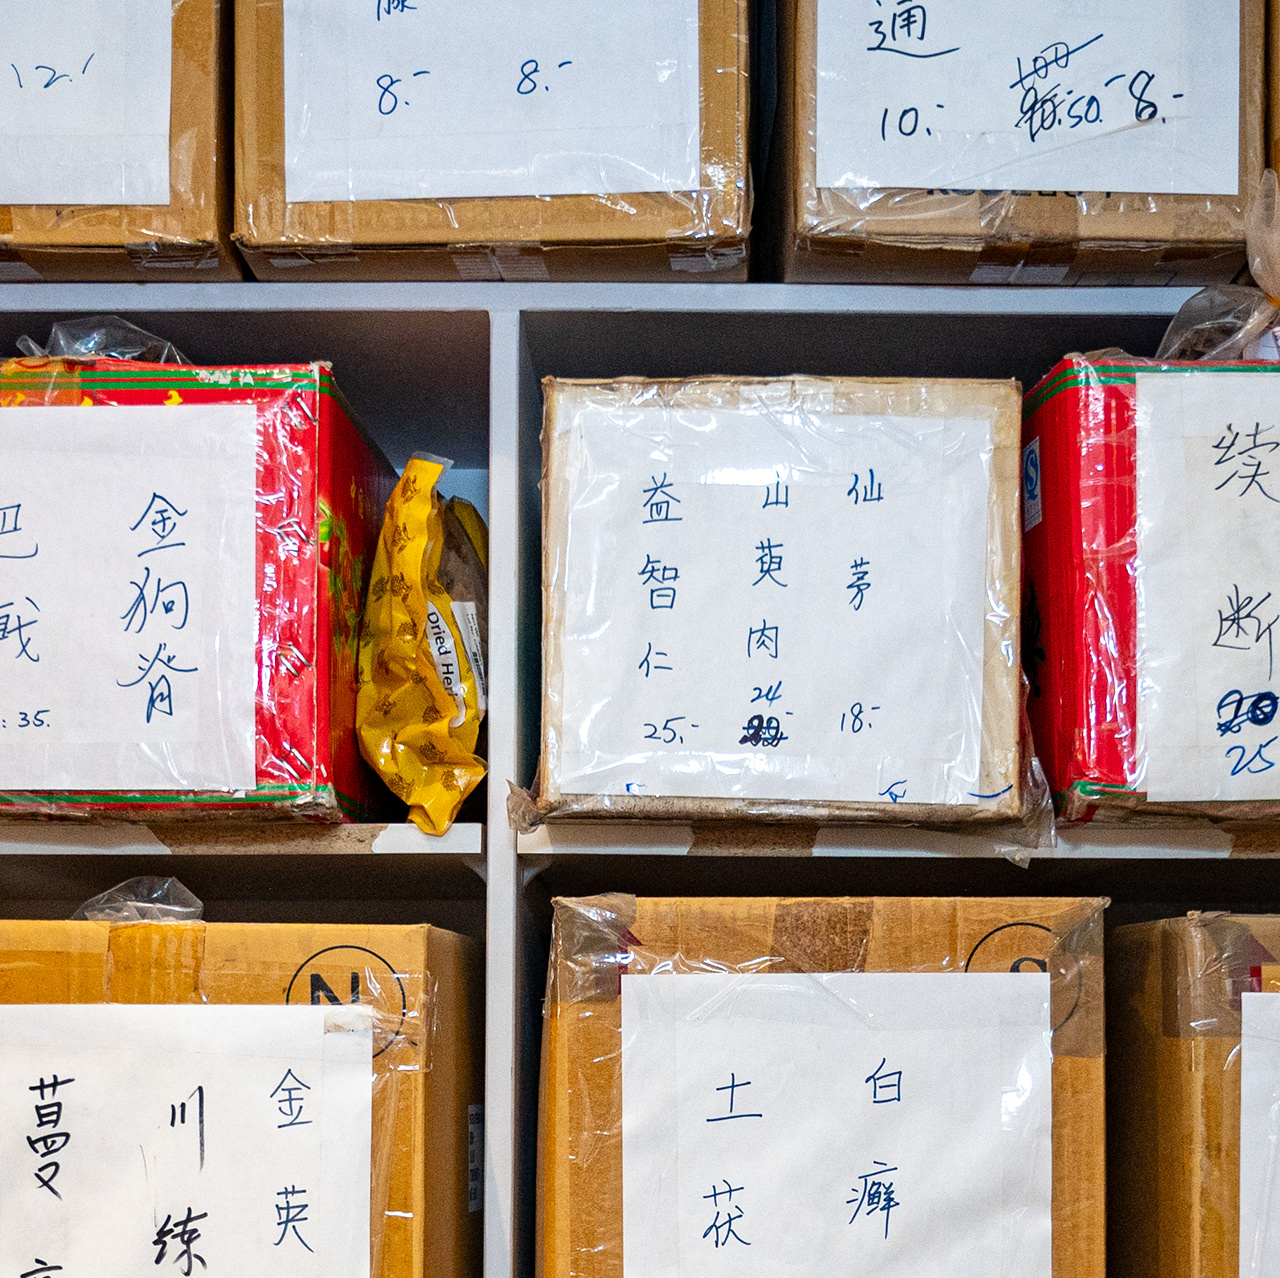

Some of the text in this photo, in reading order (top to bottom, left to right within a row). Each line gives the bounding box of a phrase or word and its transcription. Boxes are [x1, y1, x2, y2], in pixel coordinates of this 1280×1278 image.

[115, 491, 200, 725] 金狗脊
[637, 471, 684, 679] 益智仁
[746, 480, 790, 660] 山萸肉
[845, 466, 885, 612] 仙茅
[427, 611, 452, 656] Dried
